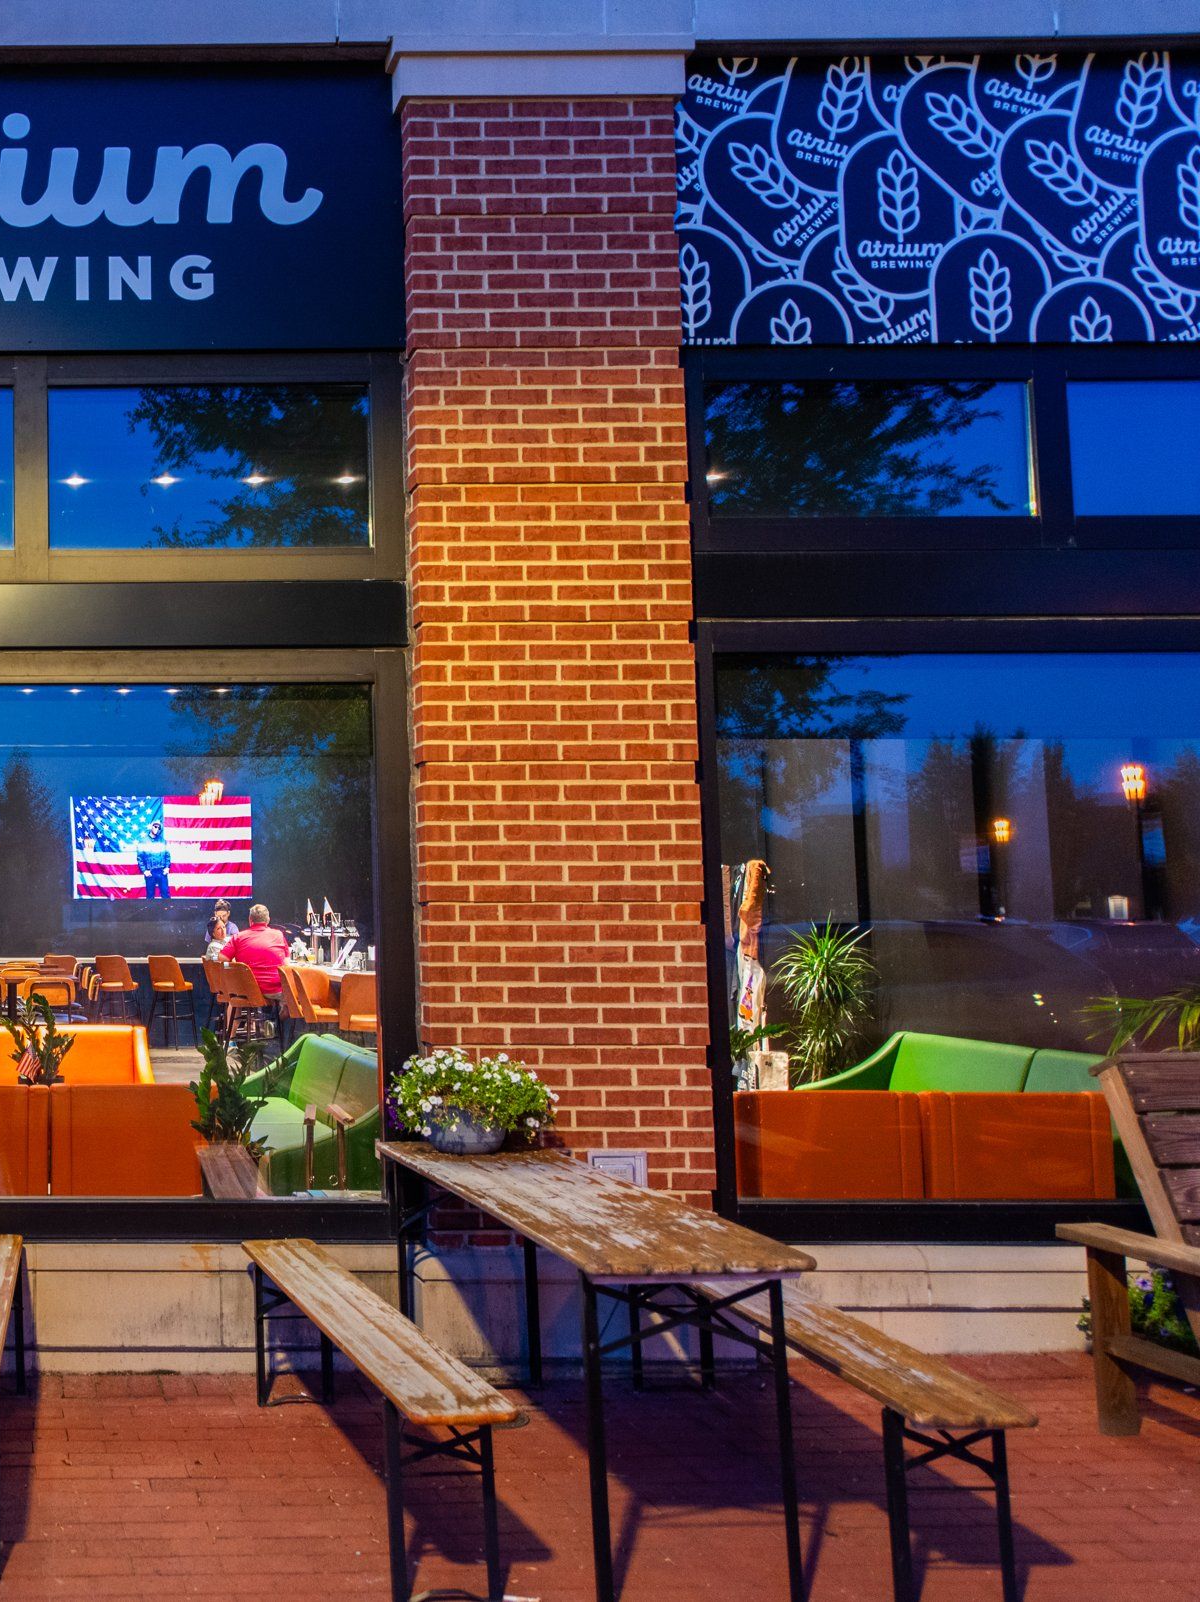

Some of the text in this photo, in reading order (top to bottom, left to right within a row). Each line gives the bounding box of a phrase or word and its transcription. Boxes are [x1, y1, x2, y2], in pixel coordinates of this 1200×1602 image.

[688, 74, 749, 102] atriu
[984, 79, 1049, 107] atriu
[696, 96, 744, 113] BREWI
[787, 129, 849, 158] atriu
[1085, 126, 1148, 154] atriu
[796, 151, 845, 168] BREWI
[1095, 148, 1140, 164] BREWI
[794, 200, 839, 247] BREWING
[1093, 199, 1140, 245] BREWING
[871, 260, 934, 269] BREWING
